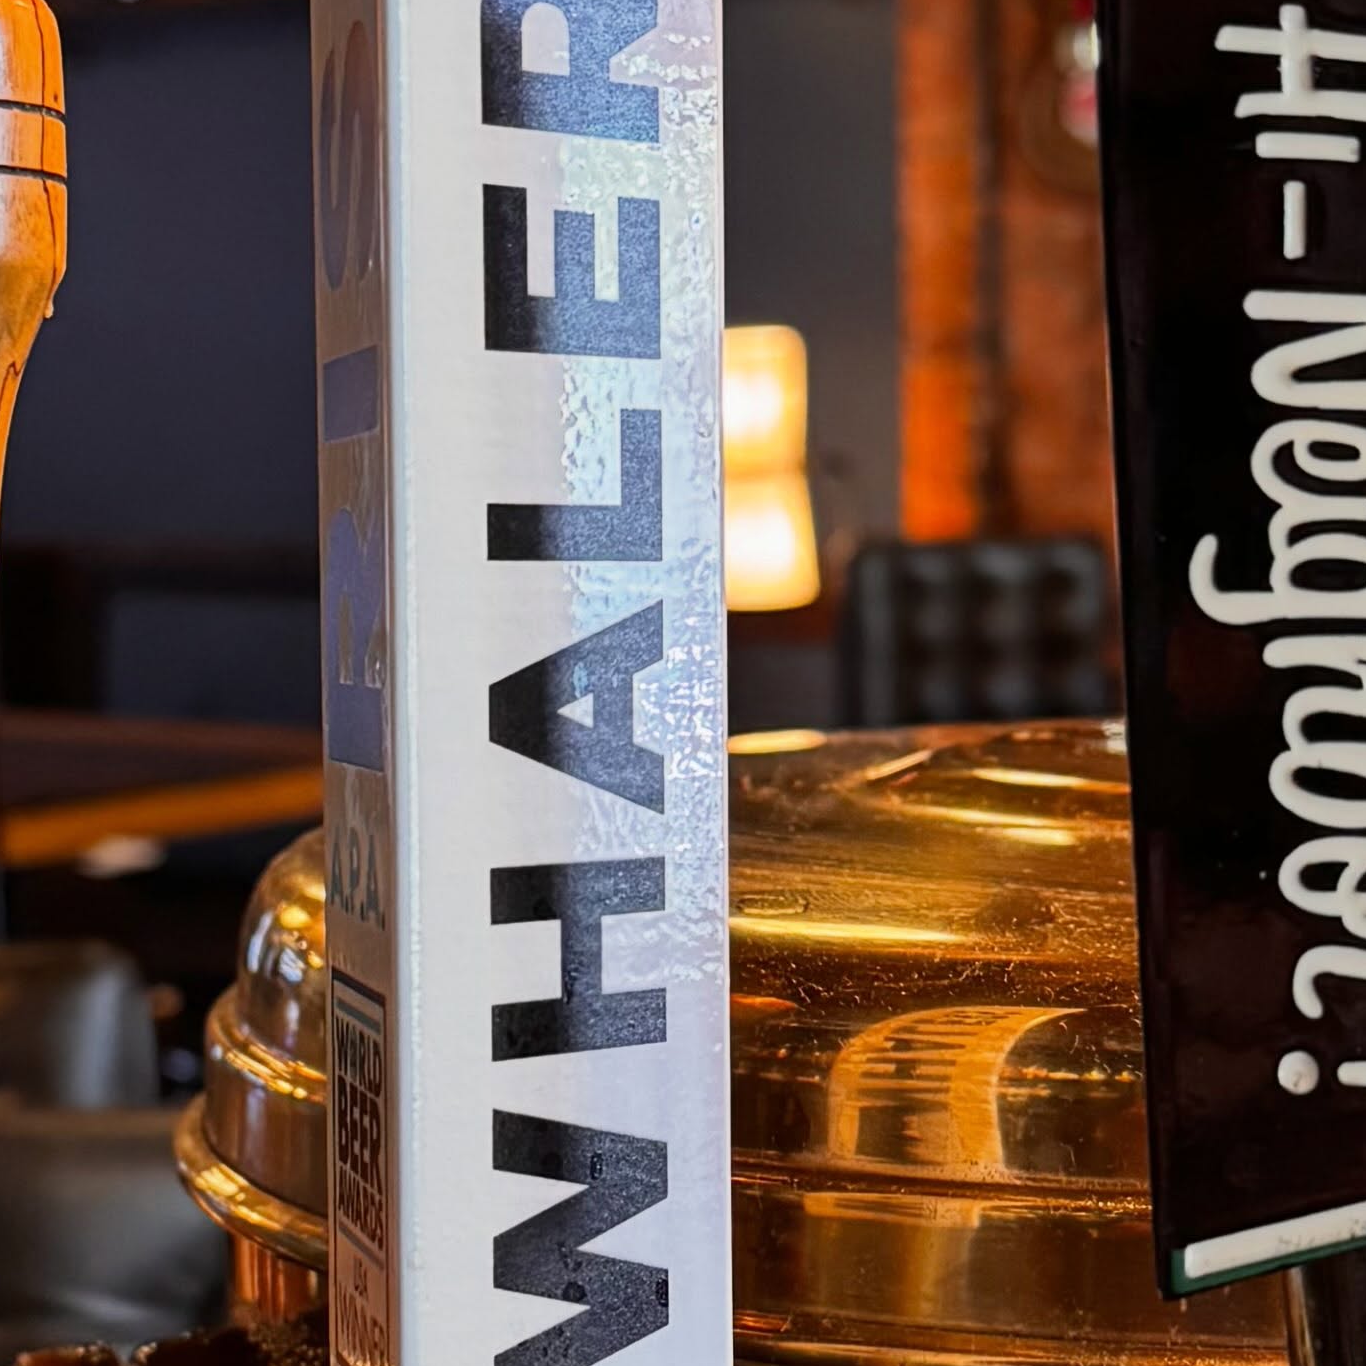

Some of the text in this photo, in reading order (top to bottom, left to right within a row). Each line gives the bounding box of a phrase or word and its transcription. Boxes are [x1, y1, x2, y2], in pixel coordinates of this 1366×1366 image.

[335, 1015, 383, 1099] WORLD
[337, 1076, 384, 1197] BEER
[337, 1165, 385, 1251] AWARDS
